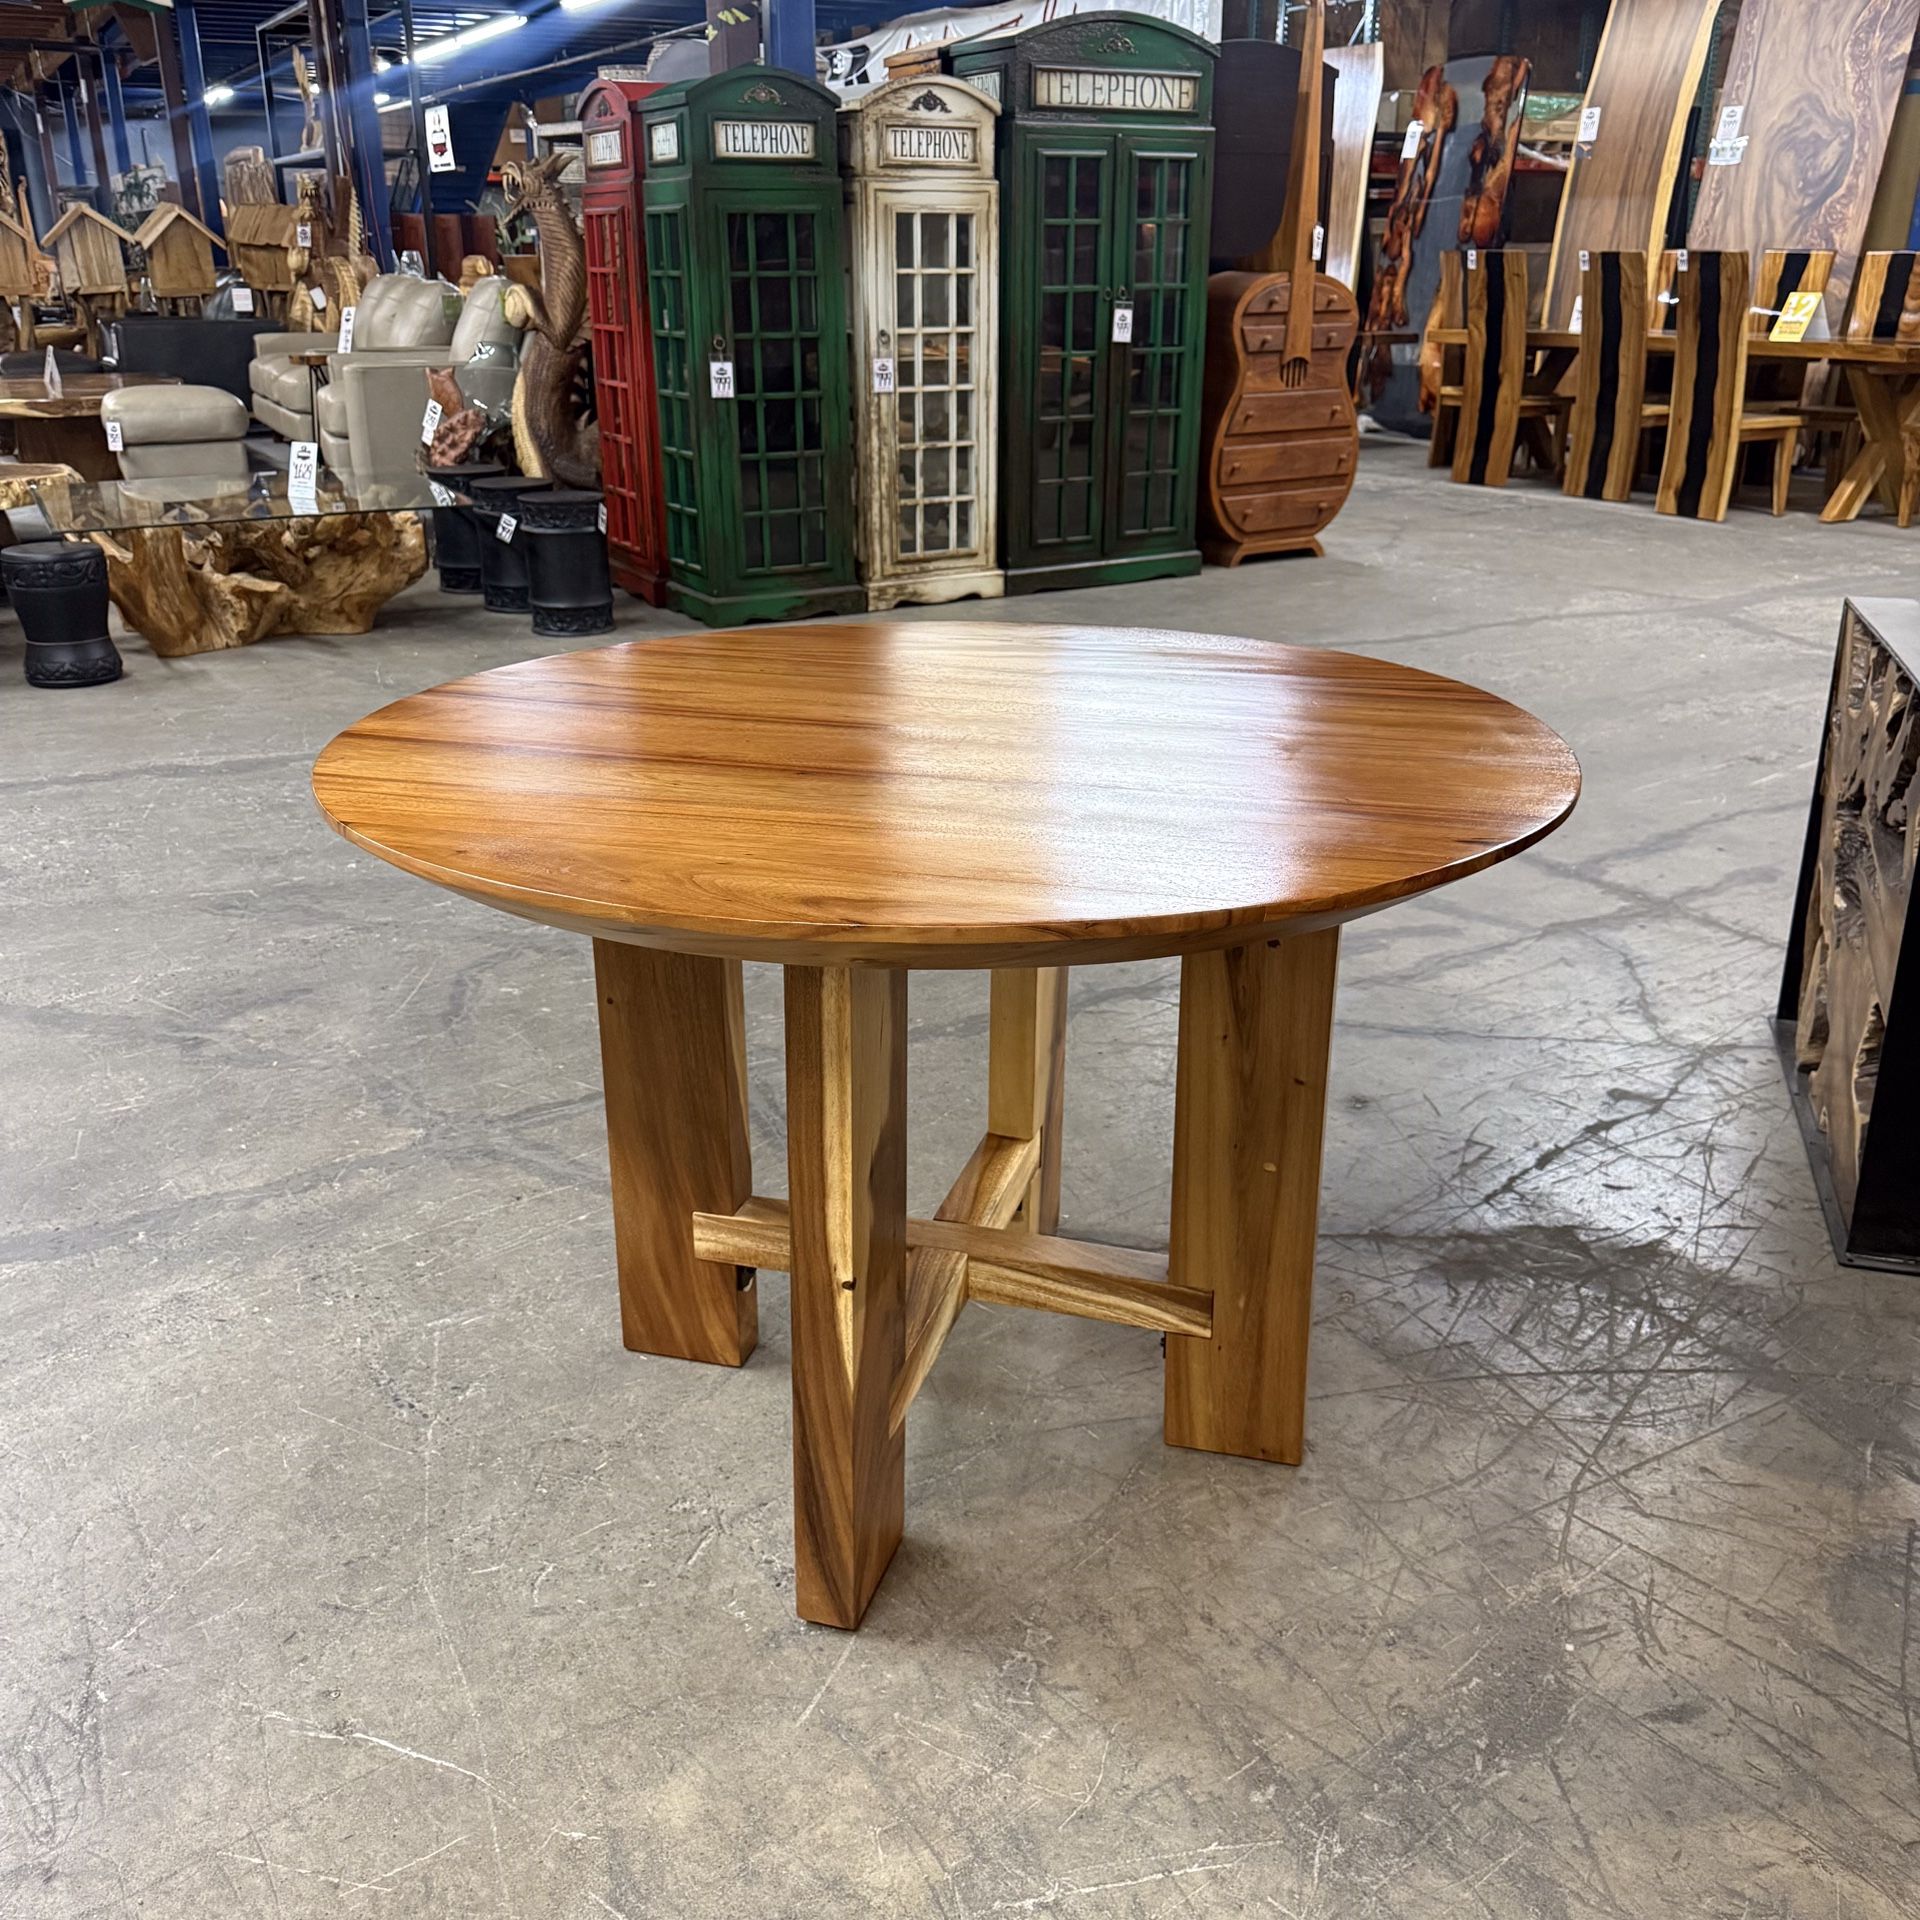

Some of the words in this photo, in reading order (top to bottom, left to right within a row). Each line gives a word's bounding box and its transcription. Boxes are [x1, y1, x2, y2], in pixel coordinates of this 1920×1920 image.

[1041, 72, 1193, 110] TELEPHONE
[722, 123, 810, 155] TELEPHONE
[891, 129, 970, 160] TELEPHONE
